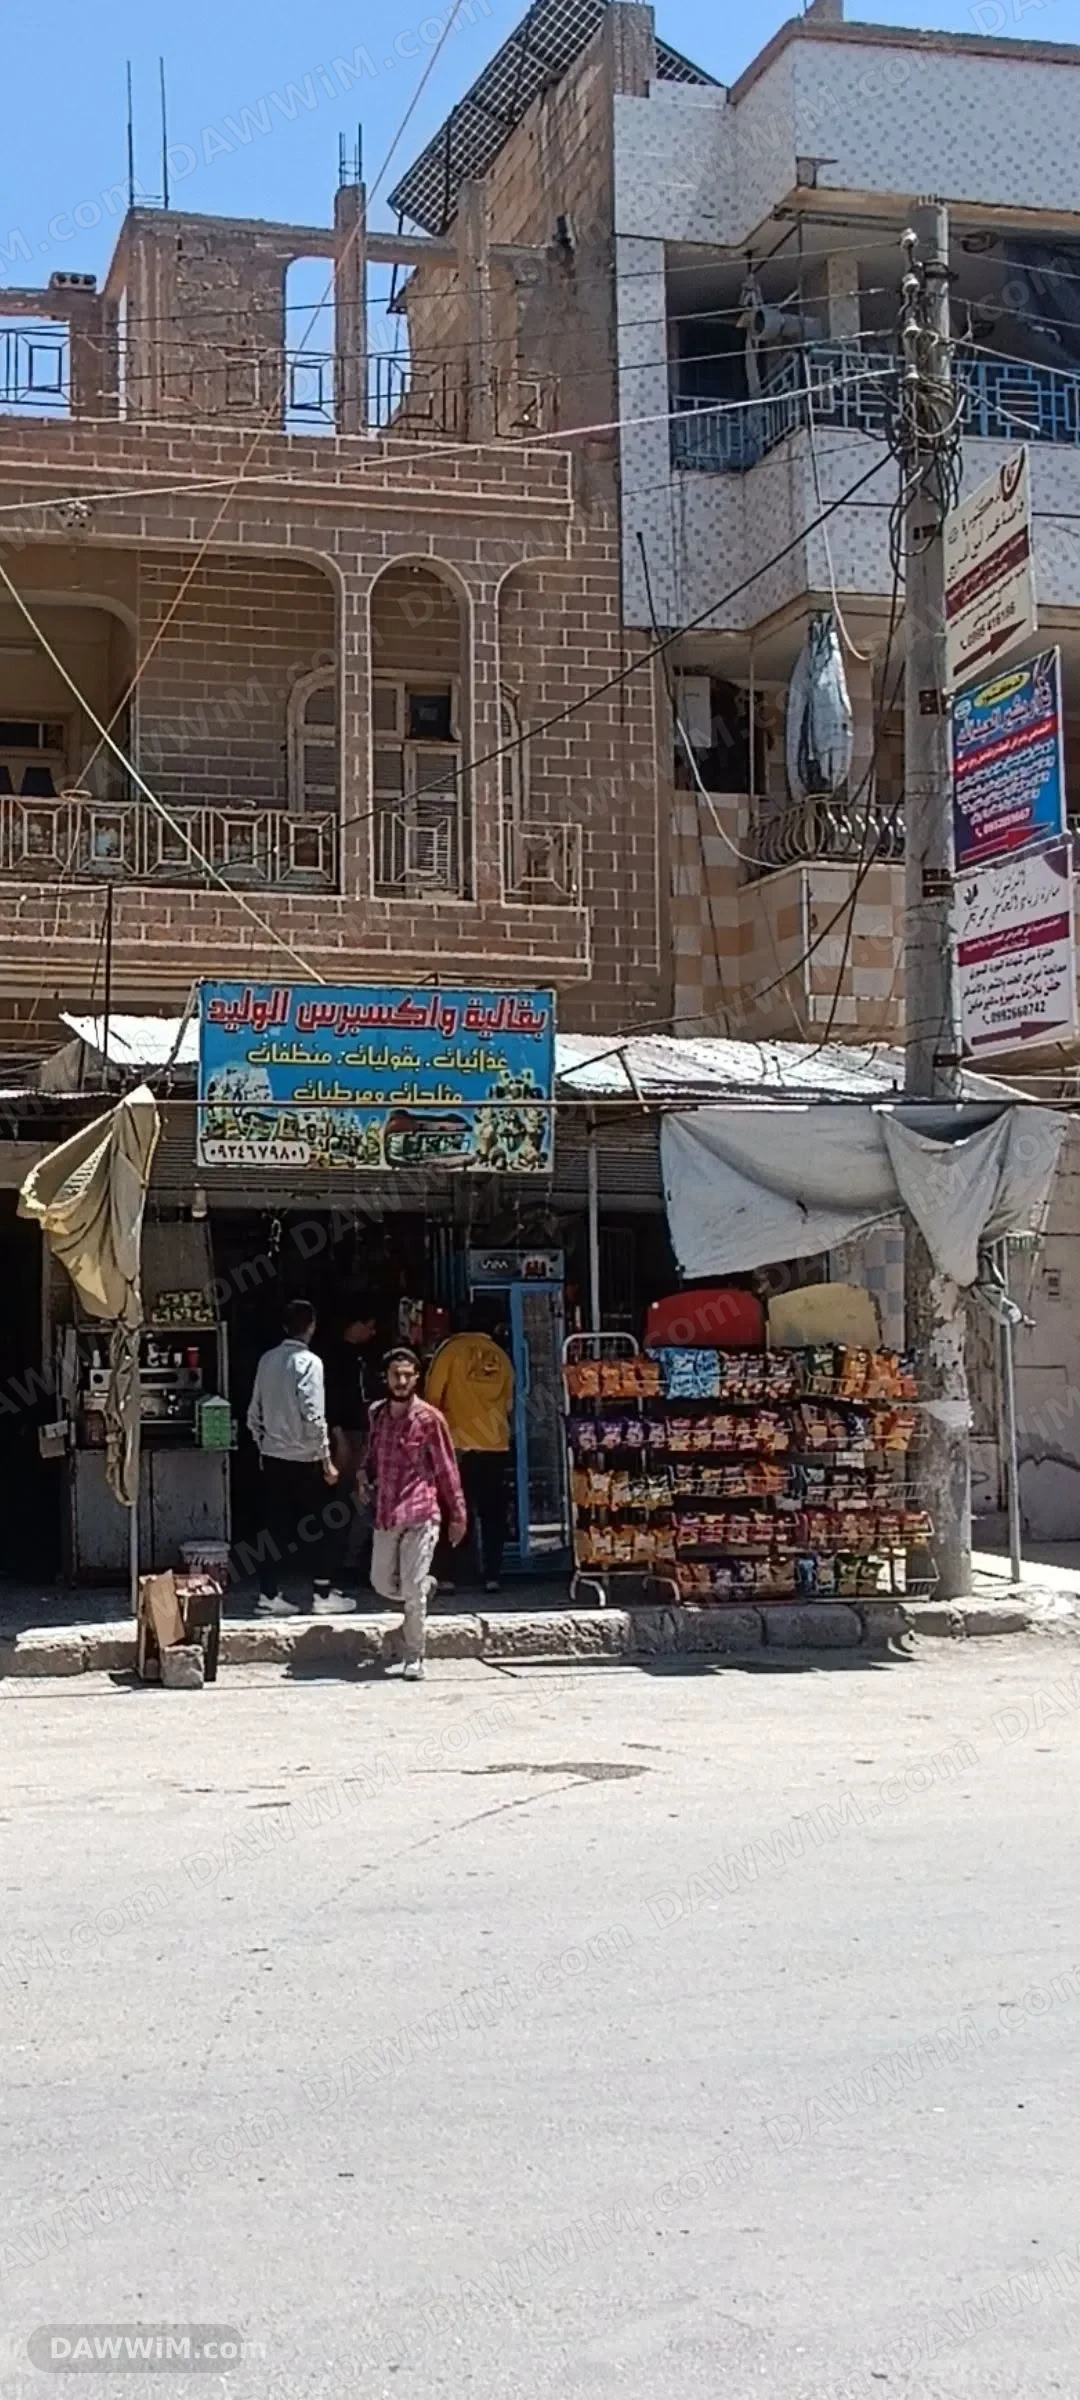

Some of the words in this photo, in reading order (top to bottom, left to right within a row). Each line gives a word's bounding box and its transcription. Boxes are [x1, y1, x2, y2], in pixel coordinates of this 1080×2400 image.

[207, 986, 293, 1033] الوليد
[462, 996, 548, 1041] بقالية
[247, 1041, 332, 1064] منظفات
